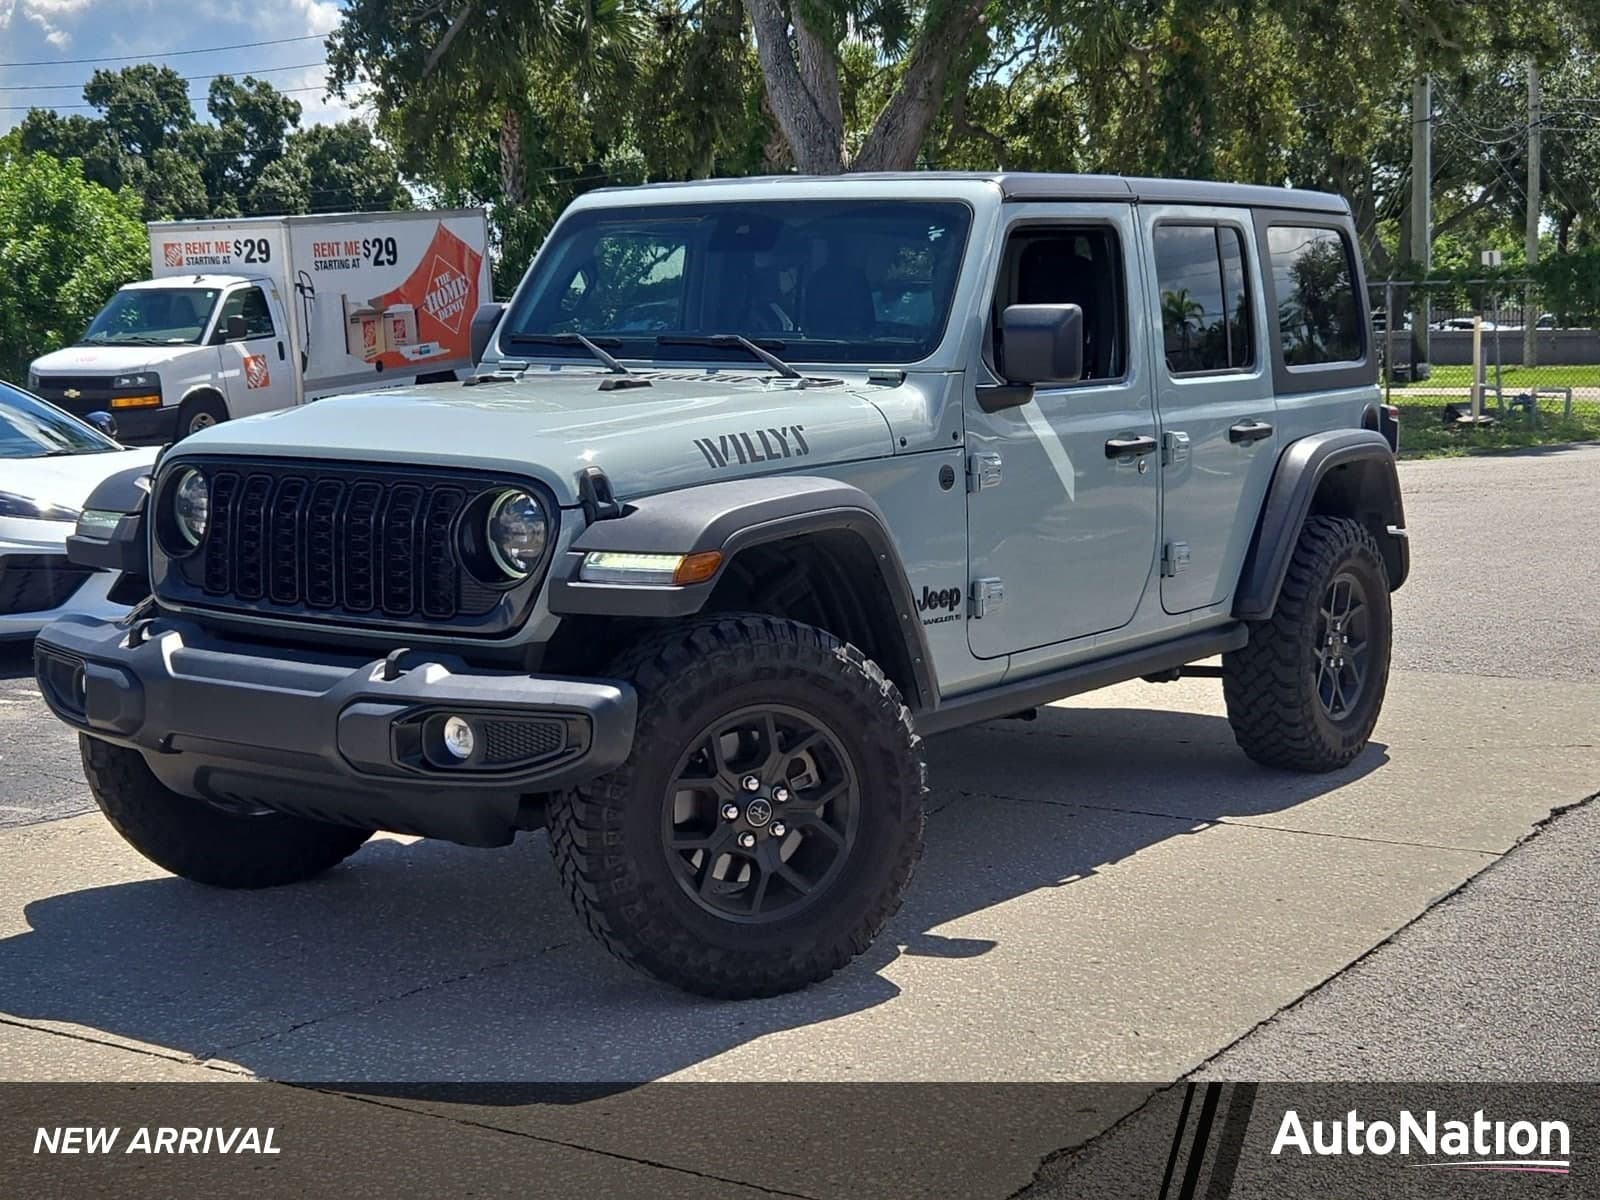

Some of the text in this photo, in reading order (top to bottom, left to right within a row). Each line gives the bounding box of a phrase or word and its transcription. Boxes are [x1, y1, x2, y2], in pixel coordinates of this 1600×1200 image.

[184, 241, 212, 255] RENT
[215, 241, 232, 254] ME
[233, 238, 271, 264] $29
[313, 240, 360, 258] RENT ME
[362, 236, 398, 267] $29
[186, 255, 232, 266] STARTING AT
[314, 258, 361, 271] STARTING AT
[433, 271, 450, 288] THE
[425, 276, 468, 313] HOME
[692, 424, 810, 469] WILLYS
[917, 585, 961, 612] Jeep
